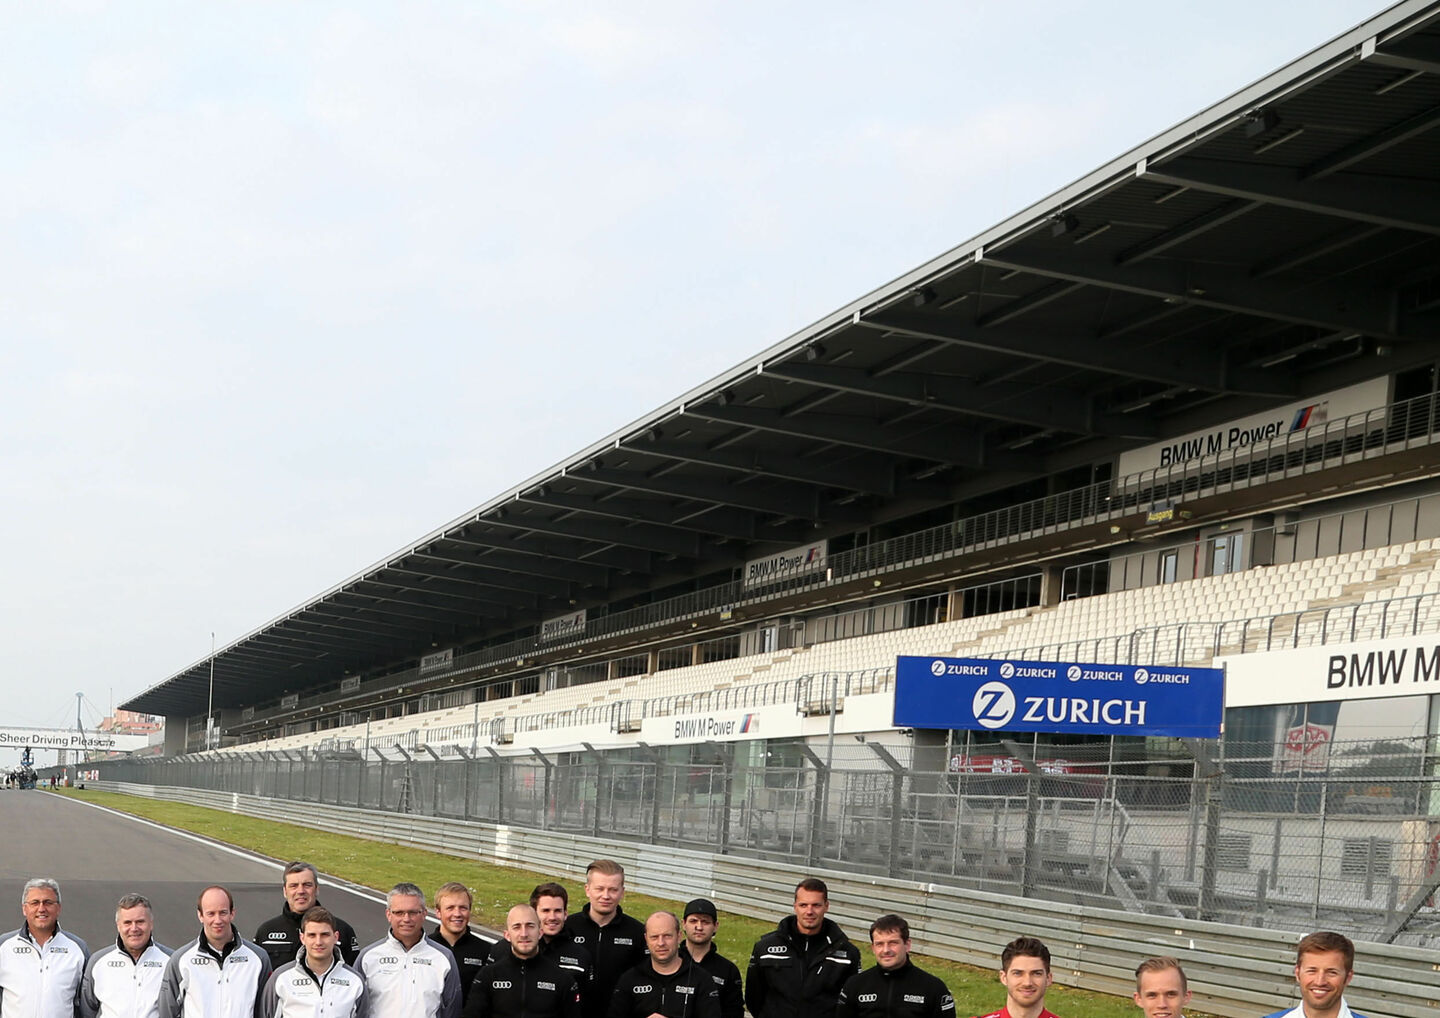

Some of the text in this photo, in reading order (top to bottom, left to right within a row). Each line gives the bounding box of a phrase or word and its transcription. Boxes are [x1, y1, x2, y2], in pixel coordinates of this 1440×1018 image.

[1160, 419, 1284, 467] BMW M Power
[750, 553, 803, 577] BMW M Power
[947, 664, 988, 676] ZURICH
[1016, 667, 1056, 678] ZURICH
[1083, 670, 1123, 682] ZURICH
[1327, 645, 1440, 690] BMW M
[1150, 673, 1189, 684] ZURICH
[1022, 696, 1146, 726] ZURICH
[674, 717, 735, 739] BMW M Power
[0, 733, 116, 748] Sheer Driving Pleasure
